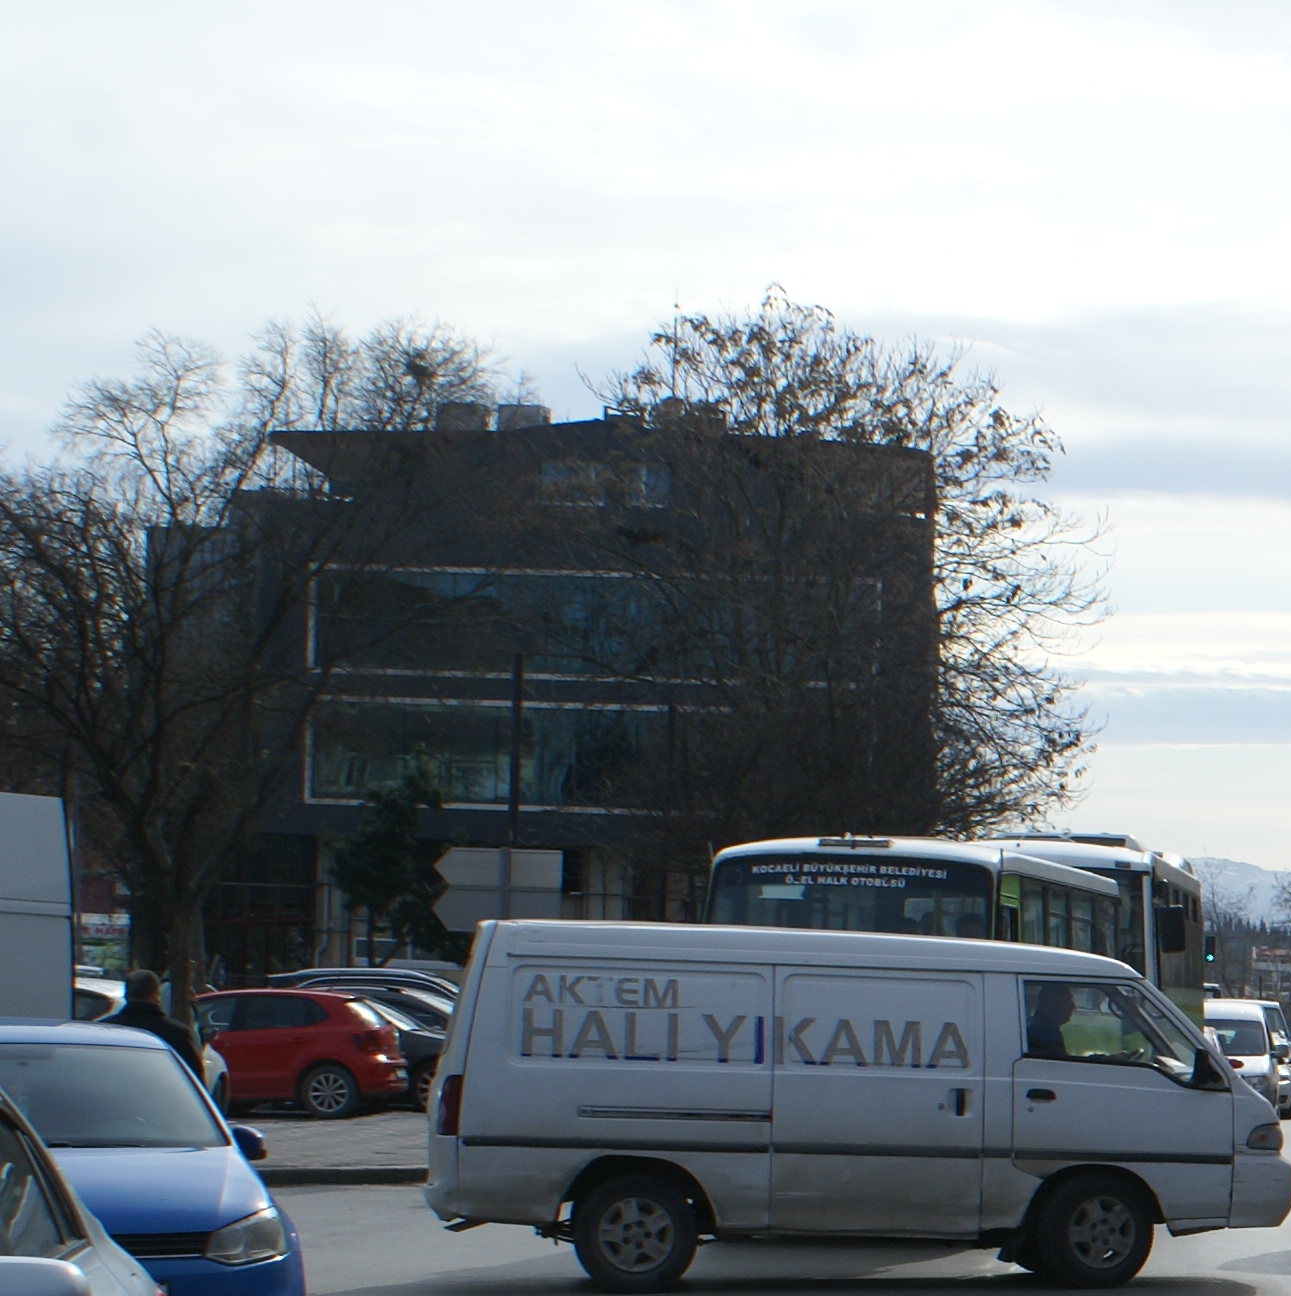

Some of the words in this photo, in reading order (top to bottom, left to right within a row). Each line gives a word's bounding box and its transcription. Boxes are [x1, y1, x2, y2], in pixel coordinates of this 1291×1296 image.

[751, 857, 800, 875] KOCAELİ
[802, 857, 877, 876] BÜYÜKŞEHİR
[879, 863, 947, 880] BELEDİYESİ
[817, 876, 849, 886] HALK
[520, 1007, 679, 1062] HALI
[701, 1013, 970, 1069] YIKAMA
